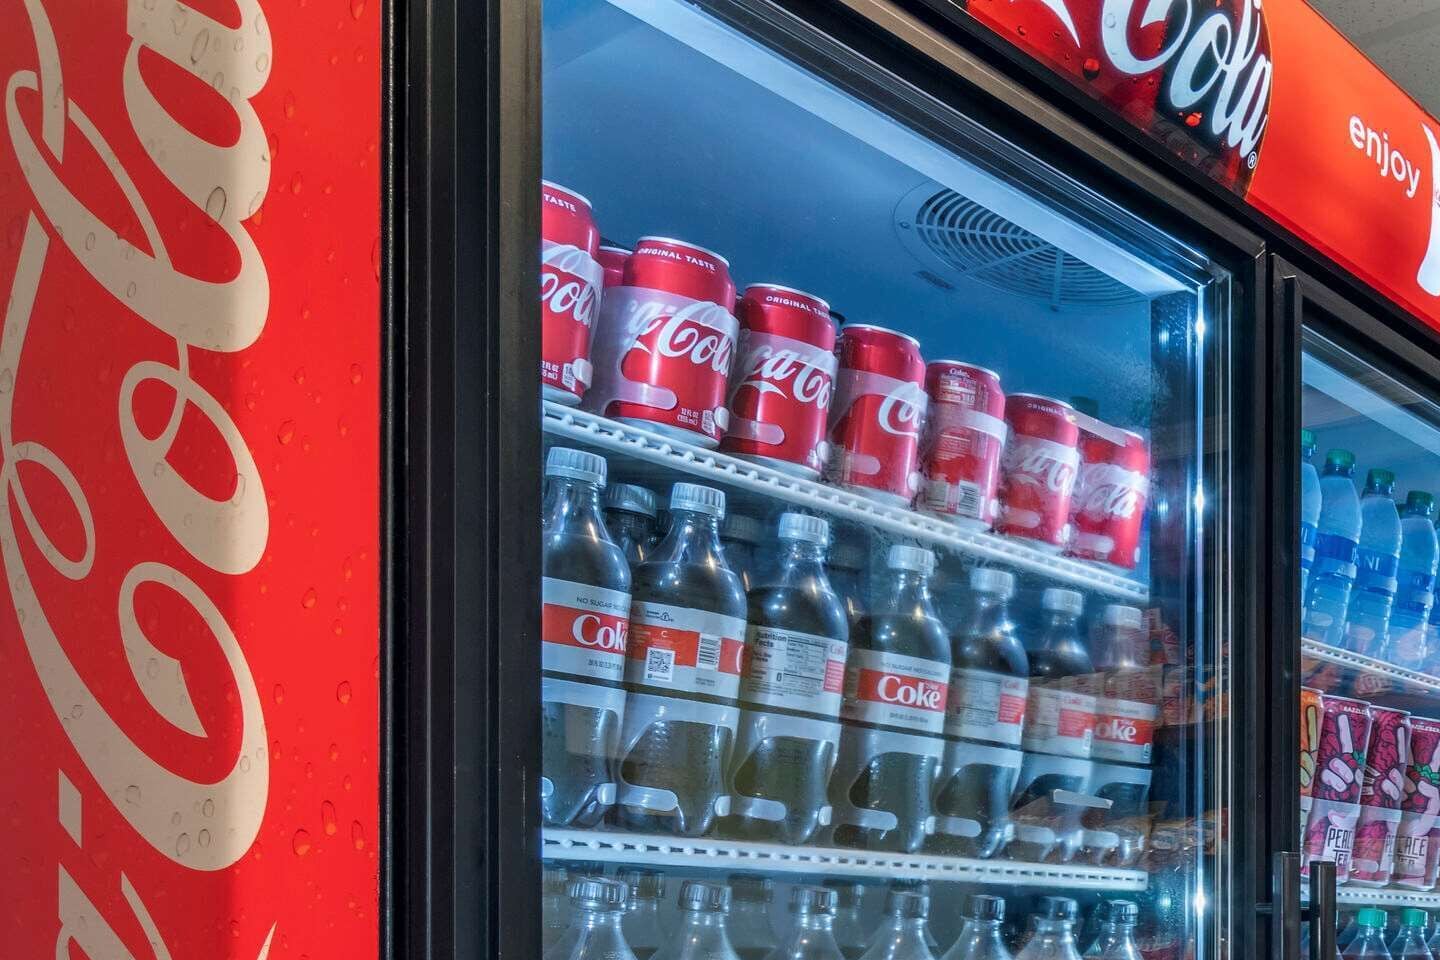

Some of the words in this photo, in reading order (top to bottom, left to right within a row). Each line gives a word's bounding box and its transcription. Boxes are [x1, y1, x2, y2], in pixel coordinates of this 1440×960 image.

[1349, 115, 1421, 198] enjoy
[544, 194, 577, 212] TASTE
[638, 247, 681, 261] ORIGINAL
[685, 255, 717, 271] TASTE
[766, 295, 811, 312] ORIGINAL
[572, 614, 627, 651] Cok
[877, 675, 941, 709] Coke
[1095, 717, 1137, 742] oke
